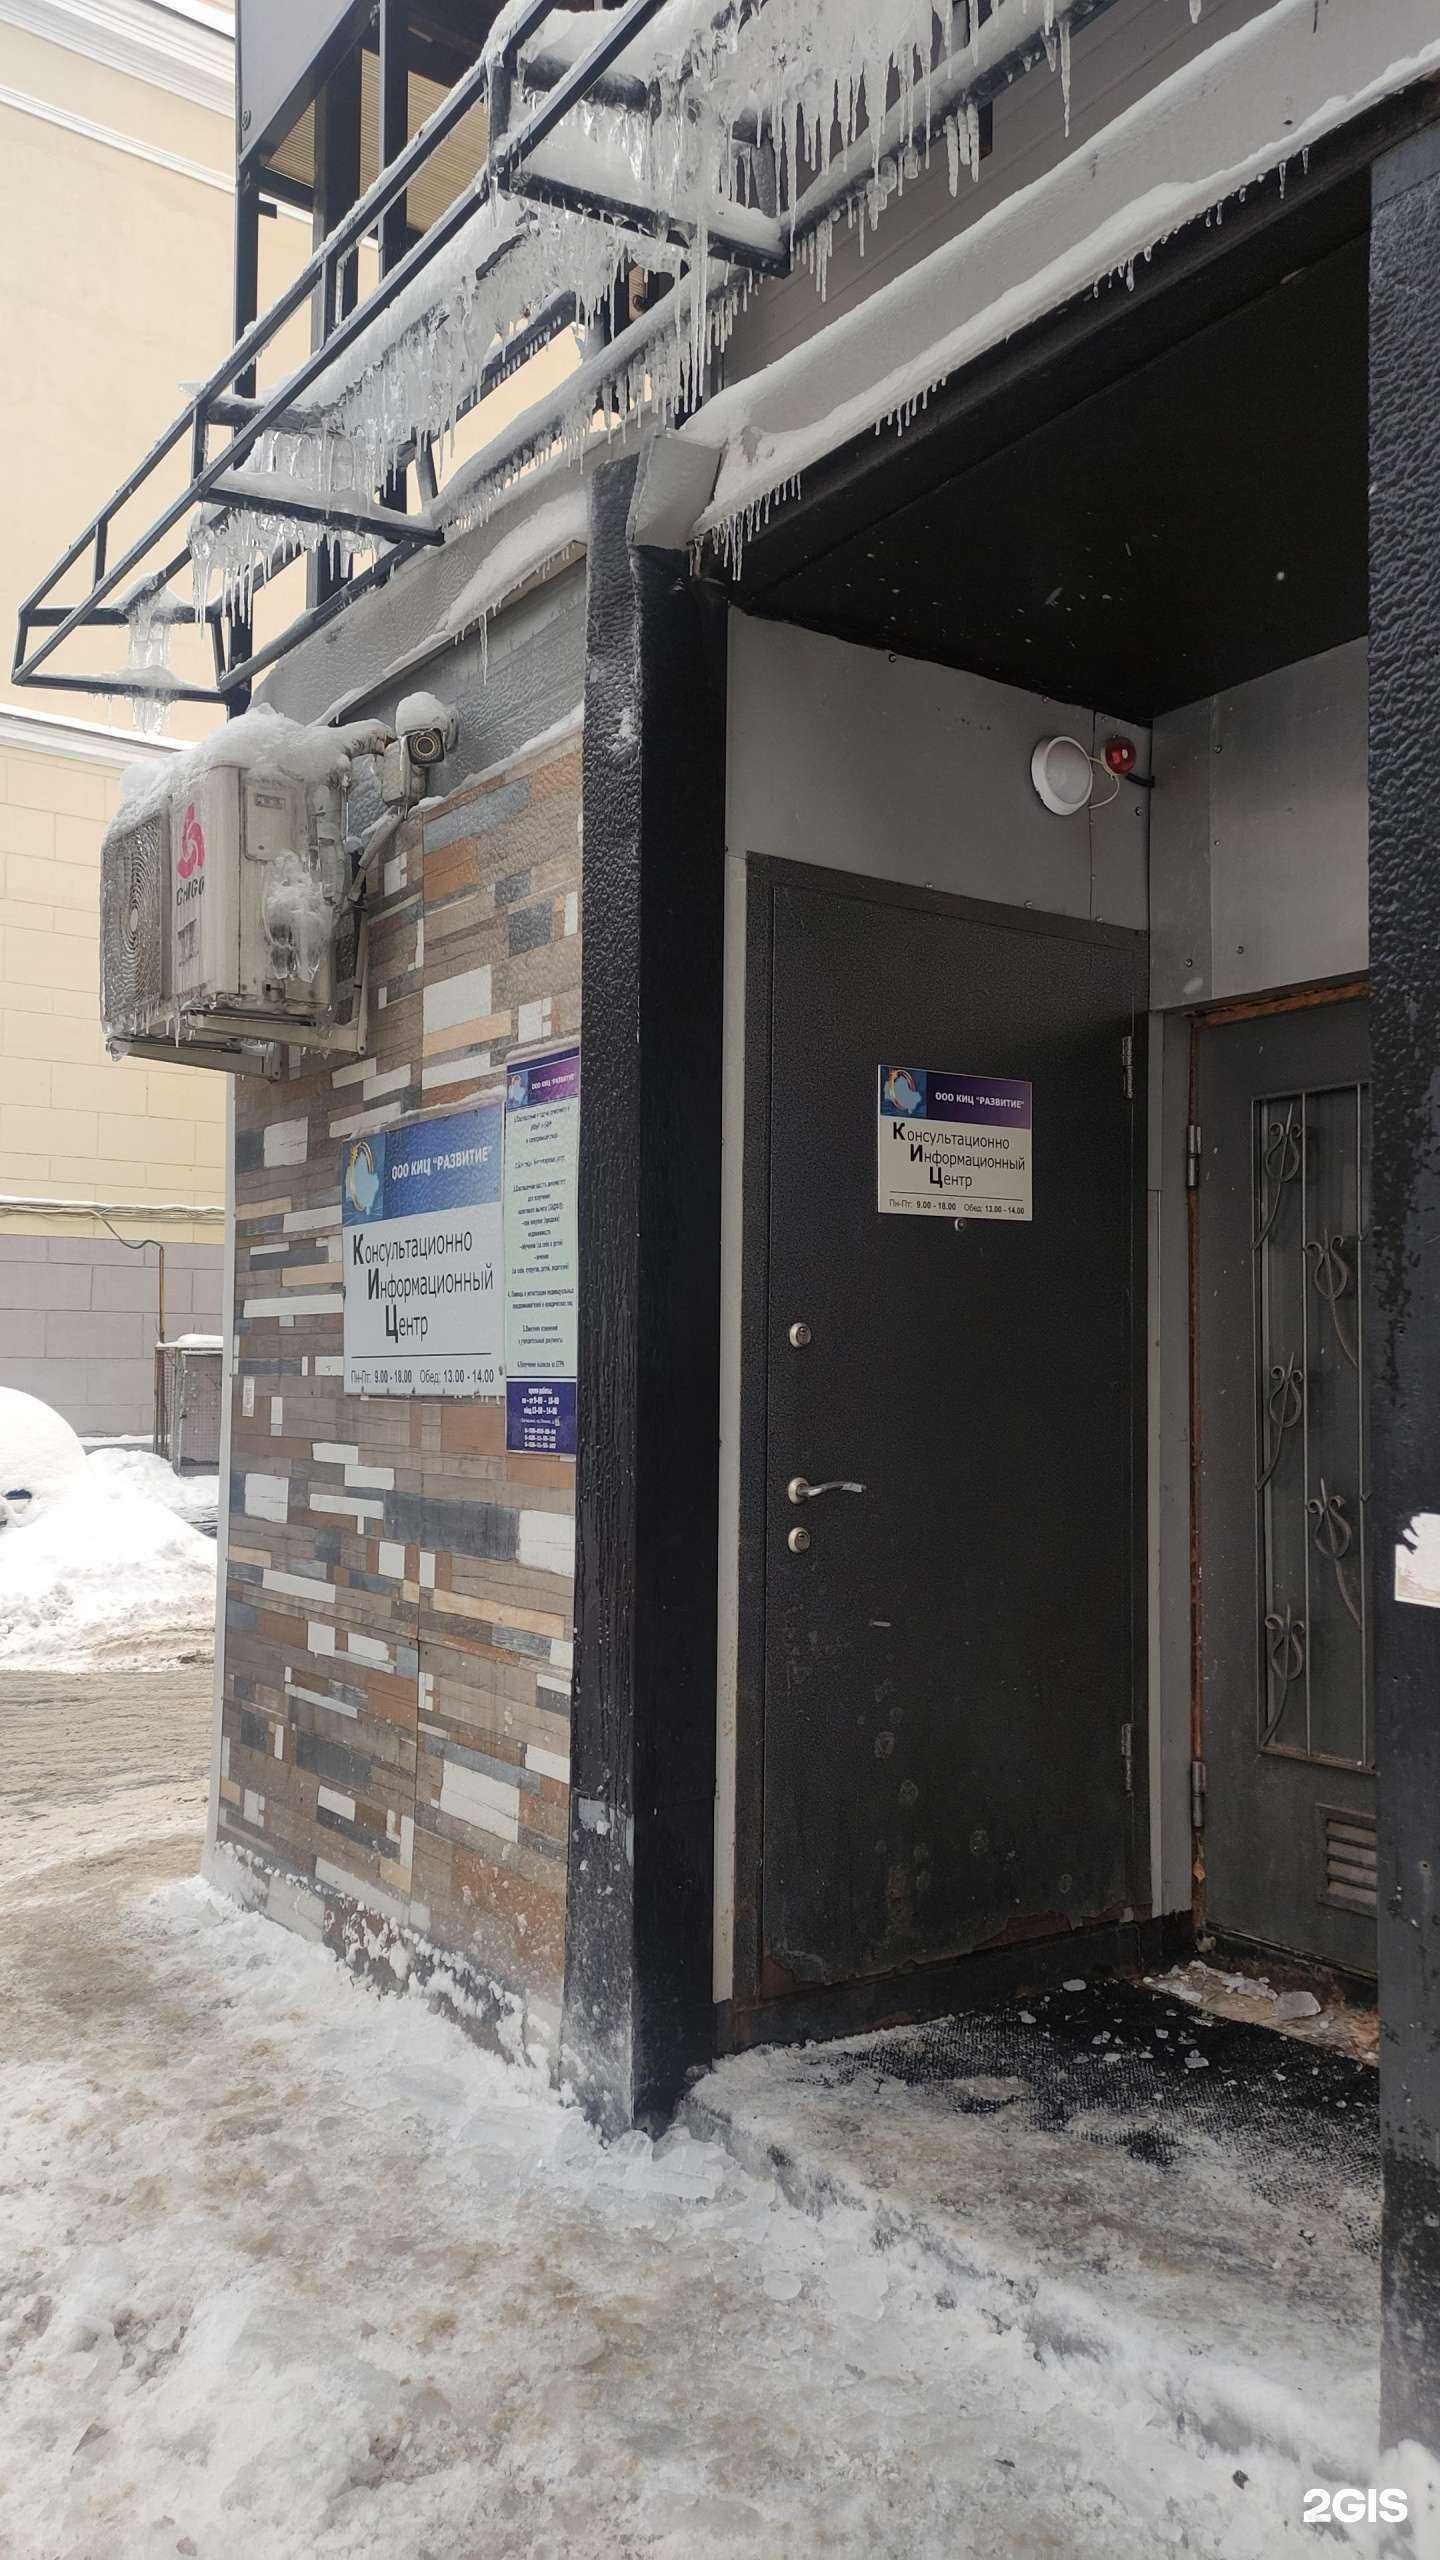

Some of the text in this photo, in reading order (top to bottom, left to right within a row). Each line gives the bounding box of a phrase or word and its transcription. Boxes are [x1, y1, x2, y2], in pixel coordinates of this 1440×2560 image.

[935, 1092, 954, 1102] ООО
[956, 1094, 975, 1106] КИЦ
[892, 1121, 1010, 1150] Консультационно
[391, 1165, 410, 1180] ООО
[411, 1158, 432, 1176] КИЦ
[910, 1143, 1025, 1171] Информационный
[929, 1166, 973, 1189] Центр
[916, 1200, 932, 1209] 9.00
[353, 1231, 473, 1267] Консультационно
[368, 1262, 494, 1303] Информационный
[385, 1304, 429, 1343] Центр
[374, 1370, 388, 1384] 9.00
[394, 1369, 413, 1384] 18.00
[443, 1369, 465, 1384] 13.00
[472, 1369, 494, 1384] 14.00
